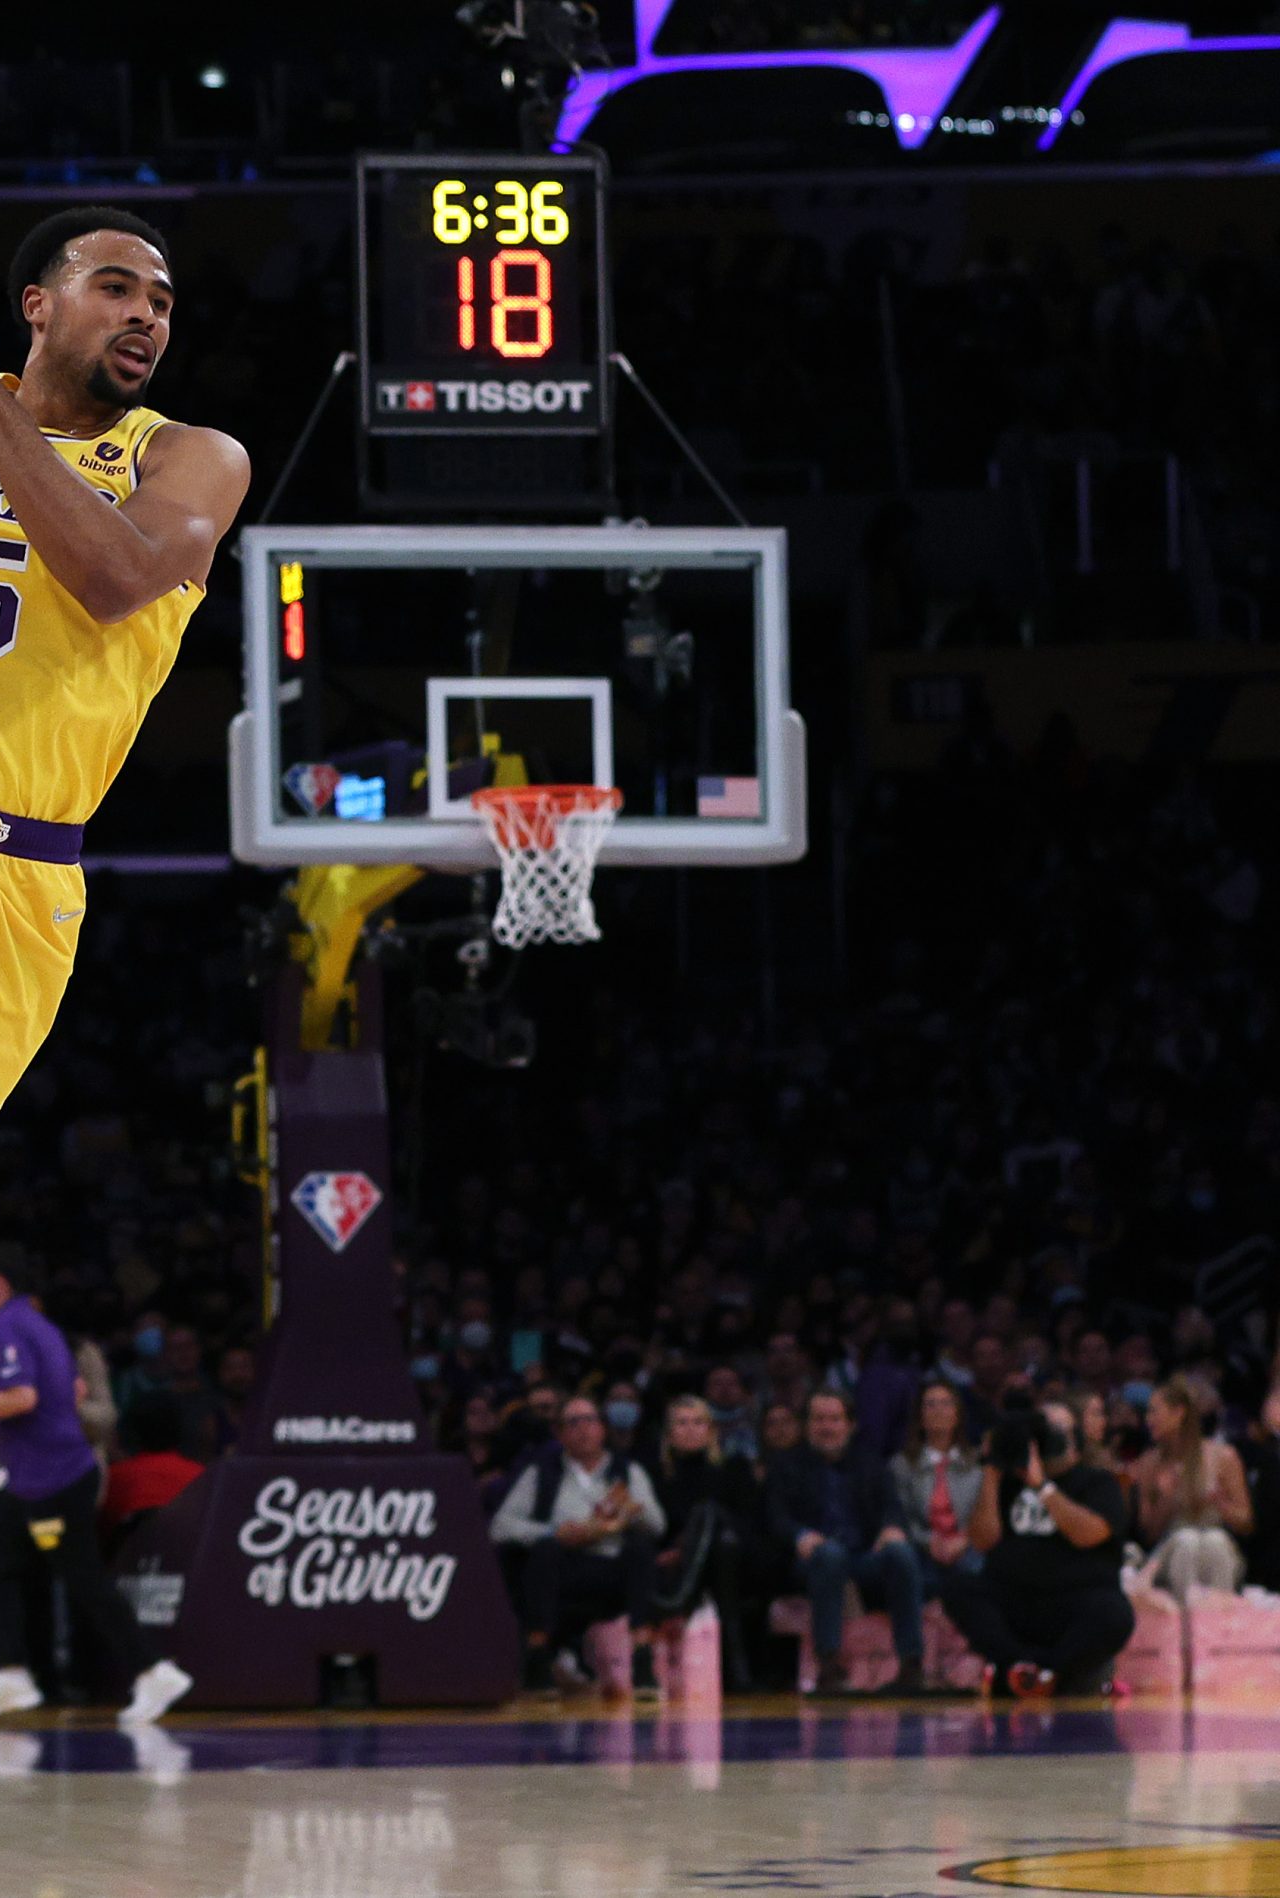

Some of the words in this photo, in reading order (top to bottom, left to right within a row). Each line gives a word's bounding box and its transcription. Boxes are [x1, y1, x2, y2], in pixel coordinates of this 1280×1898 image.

[432, 180, 570, 244] 6:36
[457, 249, 553, 358] 18
[436, 381, 592, 412] TISSOT
[78, 454, 127, 477] bibigo
[238, 1475, 437, 1558] Season
[247, 1555, 288, 1607] of
[290, 1536, 458, 1621] Giving
